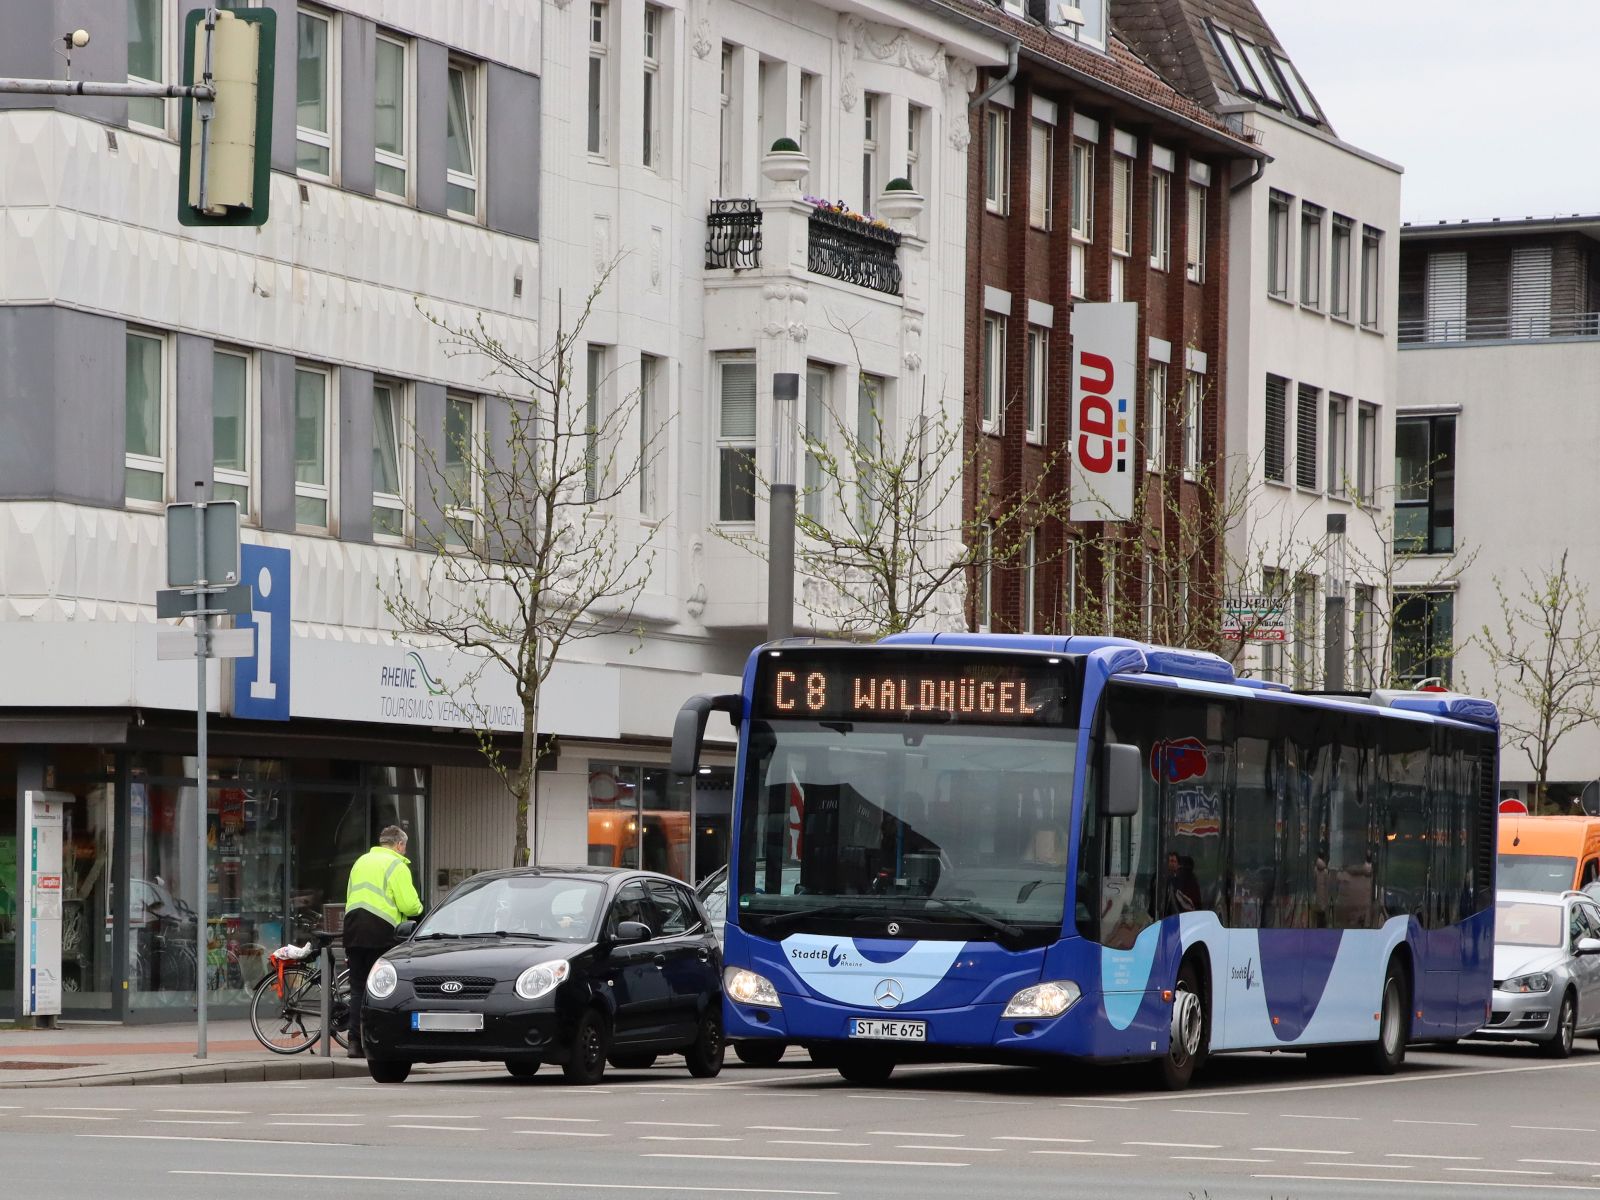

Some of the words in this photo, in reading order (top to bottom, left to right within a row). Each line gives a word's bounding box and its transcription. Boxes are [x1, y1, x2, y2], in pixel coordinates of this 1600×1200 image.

[1078, 351, 1115, 474] CDU
[776, 671, 796, 710] C
[806, 672, 826, 711] 8
[853, 677, 1035, 714] WALDHÜGEL
[840, 960, 863, 968] Rheine
[857, 1021, 874, 1035] ST
[881, 1023, 898, 1036] ME
[900, 1024, 924, 1038] 675
